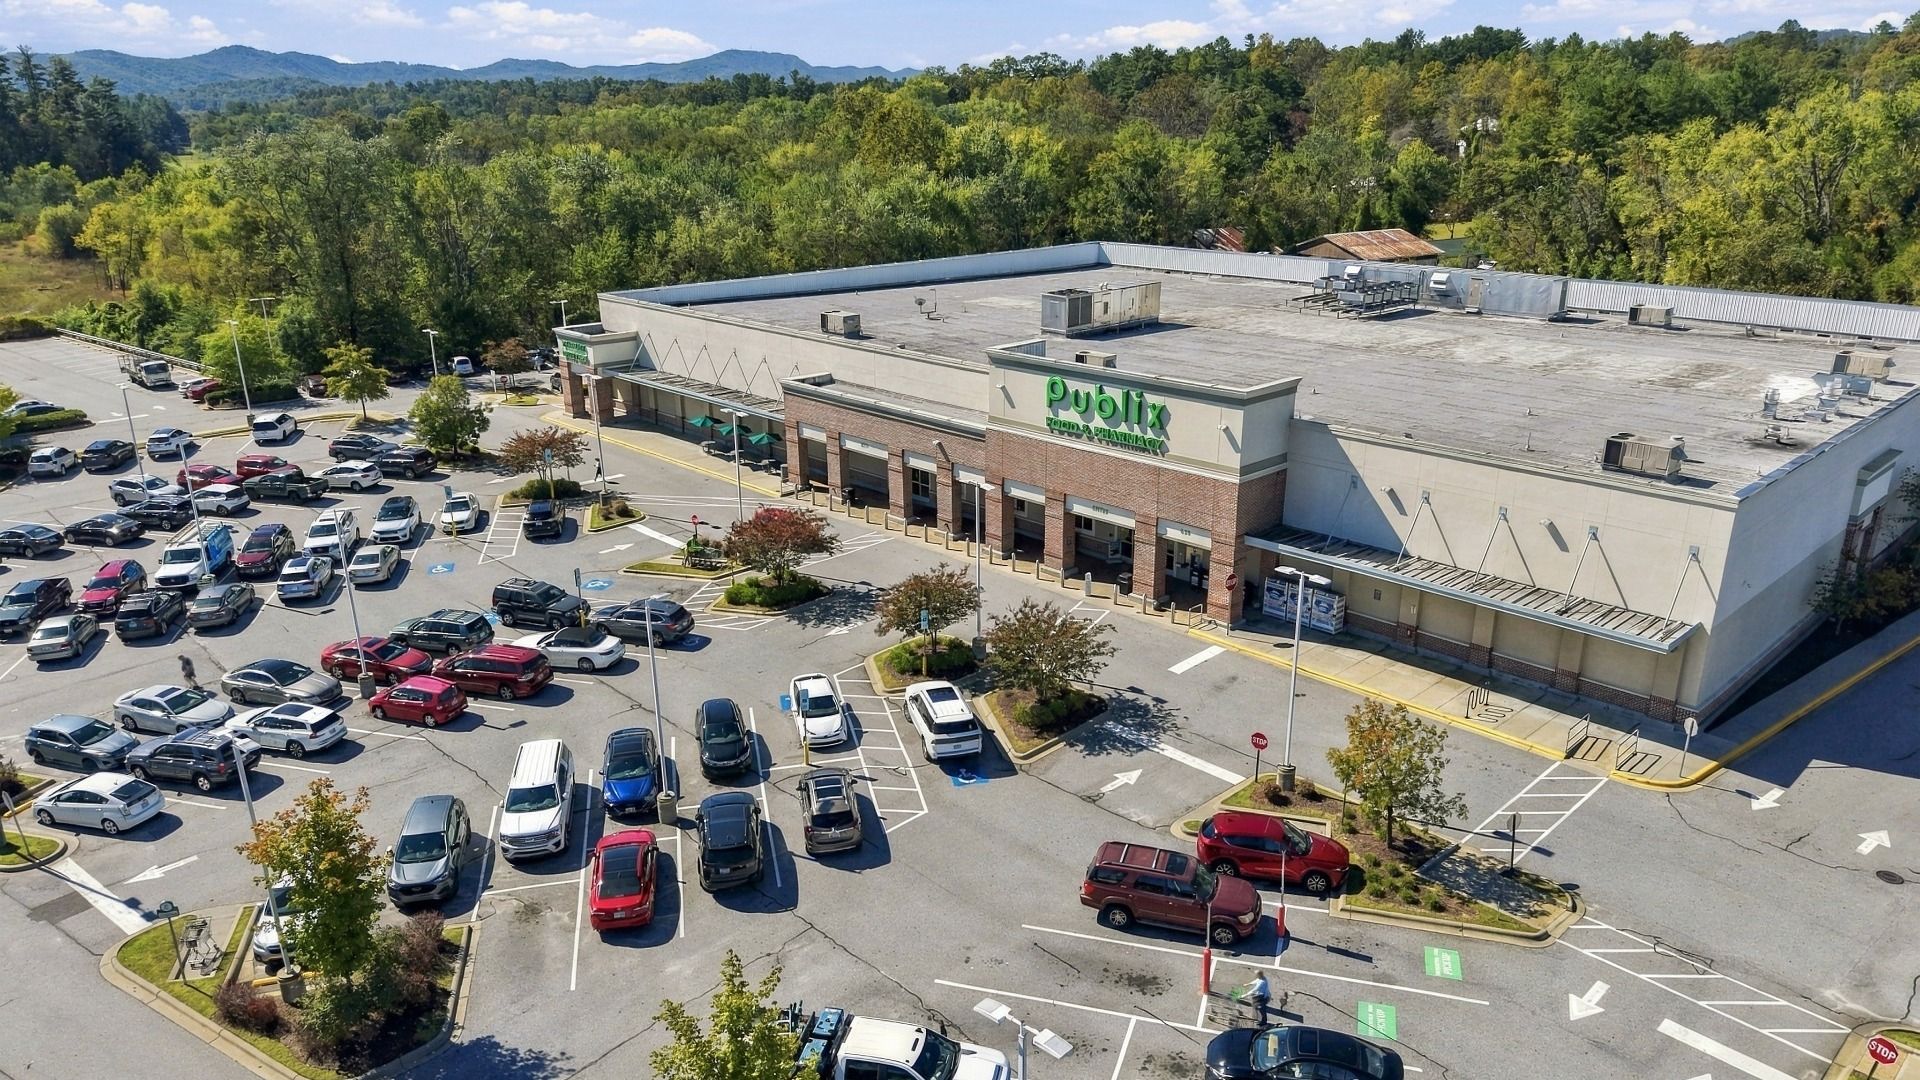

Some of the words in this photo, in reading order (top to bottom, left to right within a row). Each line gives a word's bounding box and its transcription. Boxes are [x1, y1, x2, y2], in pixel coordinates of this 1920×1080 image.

[1046, 376, 1165, 430] Publix
[1046, 416, 1080, 432] FOOD
[1082, 424, 1093, 438] &
[1094, 426, 1164, 450] PHARMACY
[1252, 736, 1268, 746] STOP
[1869, 1041, 1896, 1060] STOP
